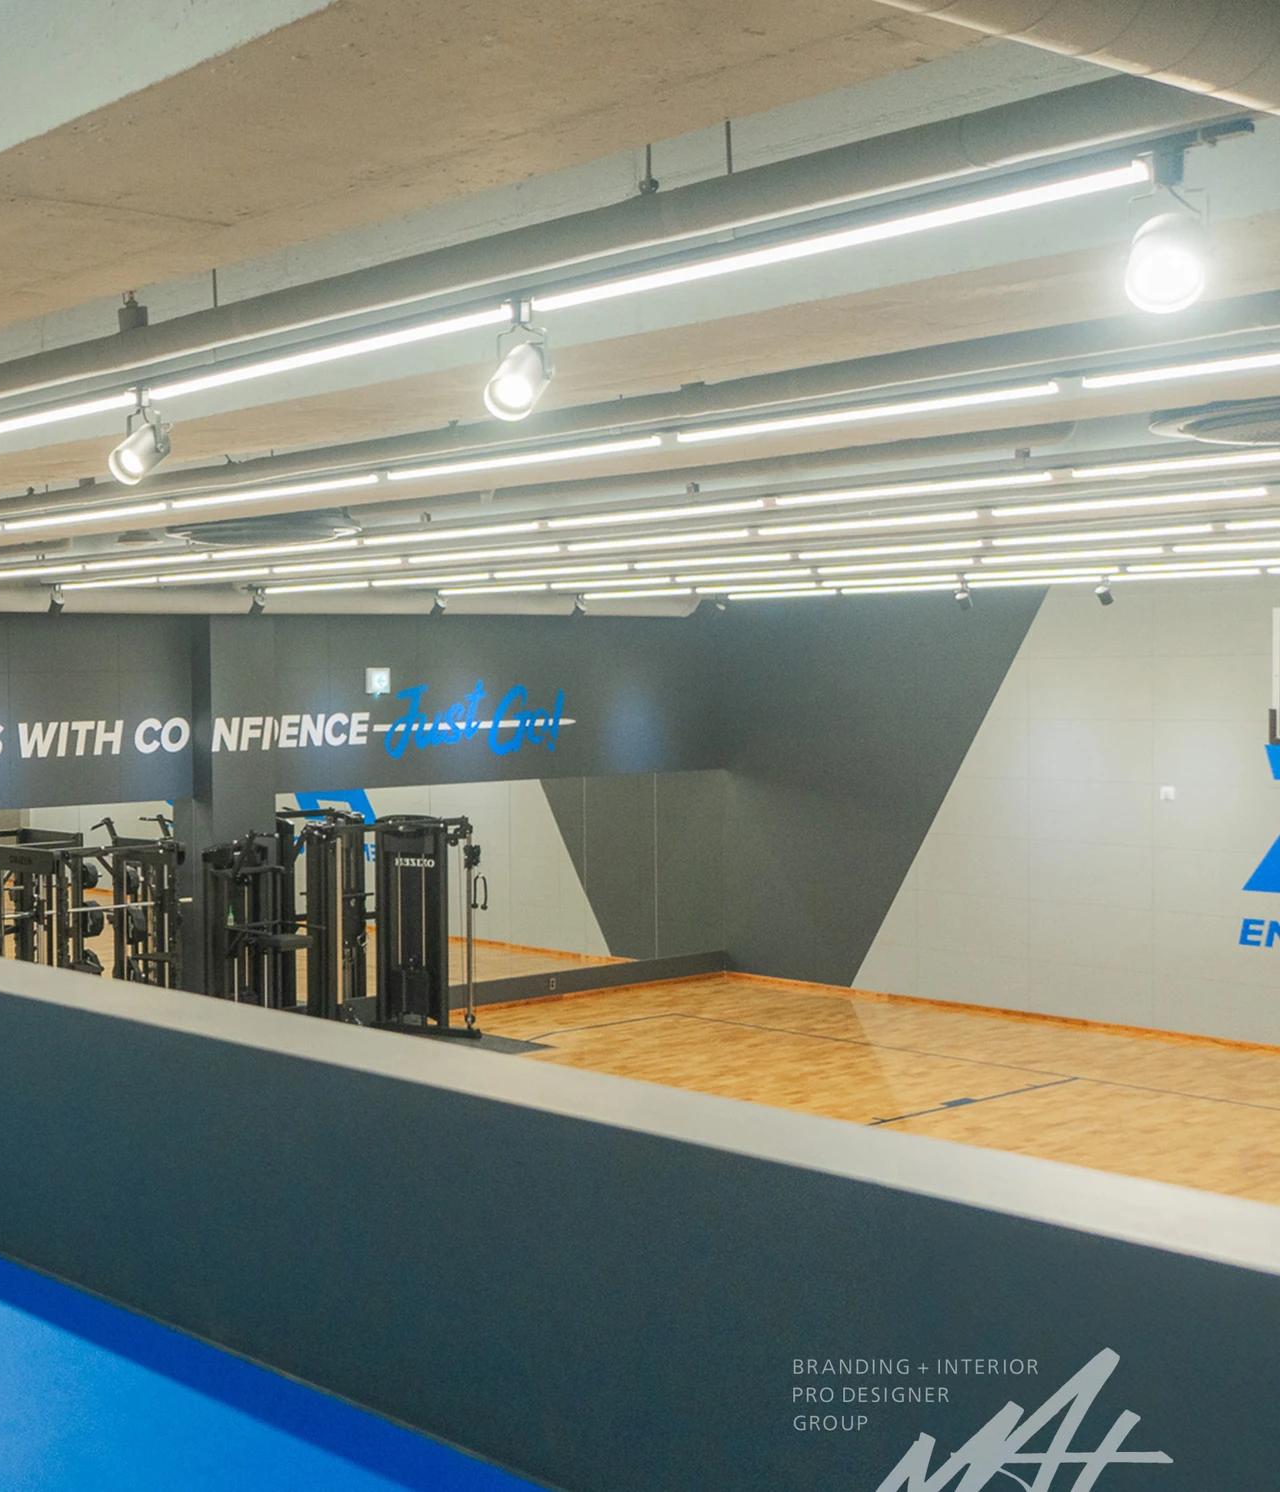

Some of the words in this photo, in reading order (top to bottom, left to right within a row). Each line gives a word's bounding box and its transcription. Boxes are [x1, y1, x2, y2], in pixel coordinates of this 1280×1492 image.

[17, 720, 124, 758] WITH
[384, 679, 487, 760] Just
[487, 684, 565, 756] Go!
